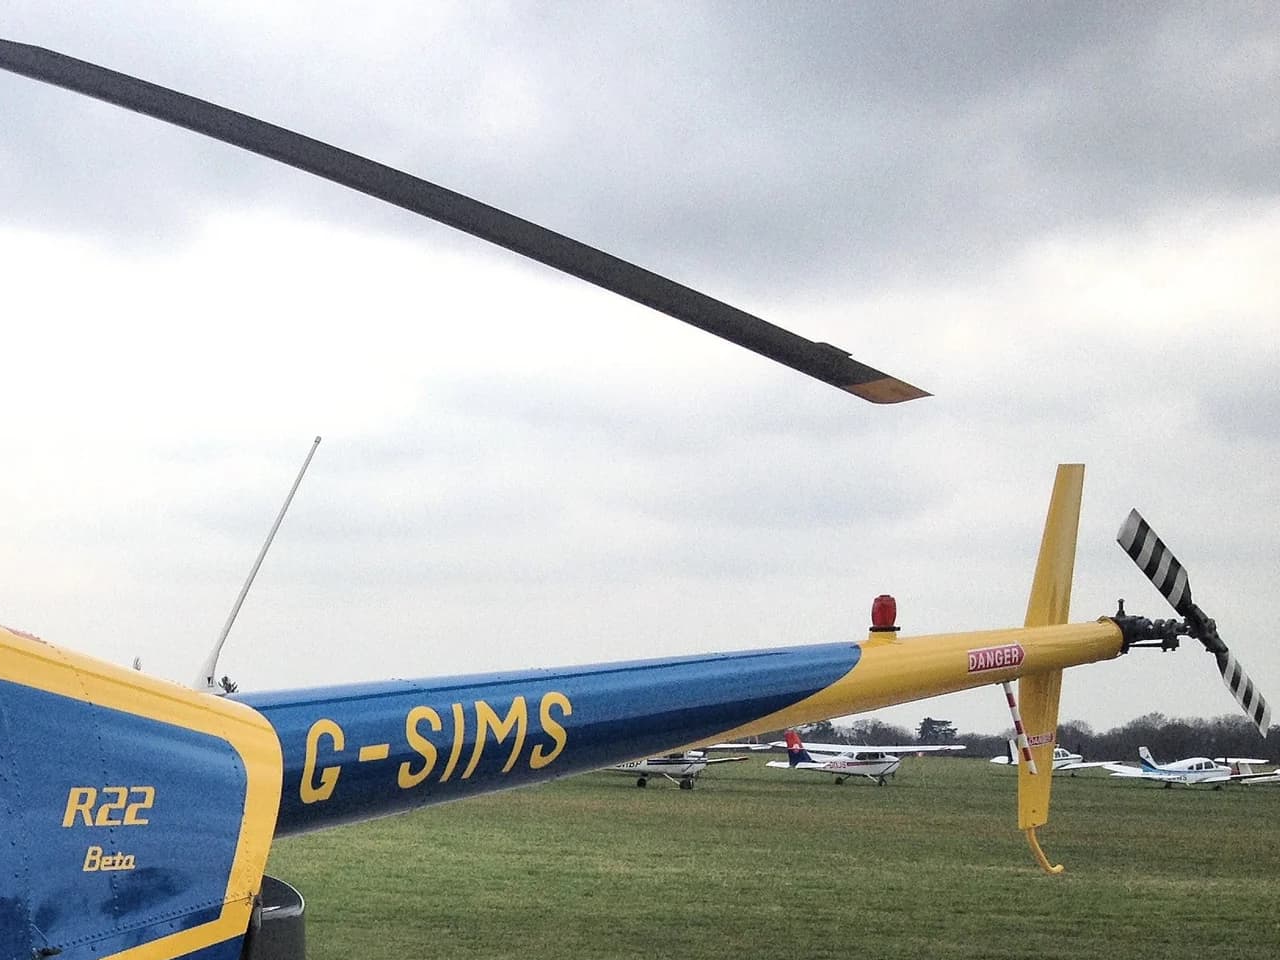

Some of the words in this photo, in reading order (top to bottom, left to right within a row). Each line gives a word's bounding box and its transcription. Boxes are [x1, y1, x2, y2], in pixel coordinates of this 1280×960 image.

[969, 647, 1020, 671] DANGER
[299, 691, 573, 805] G-SIMS
[62, 786, 155, 828] R22
[83, 845, 136, 872] Beta
